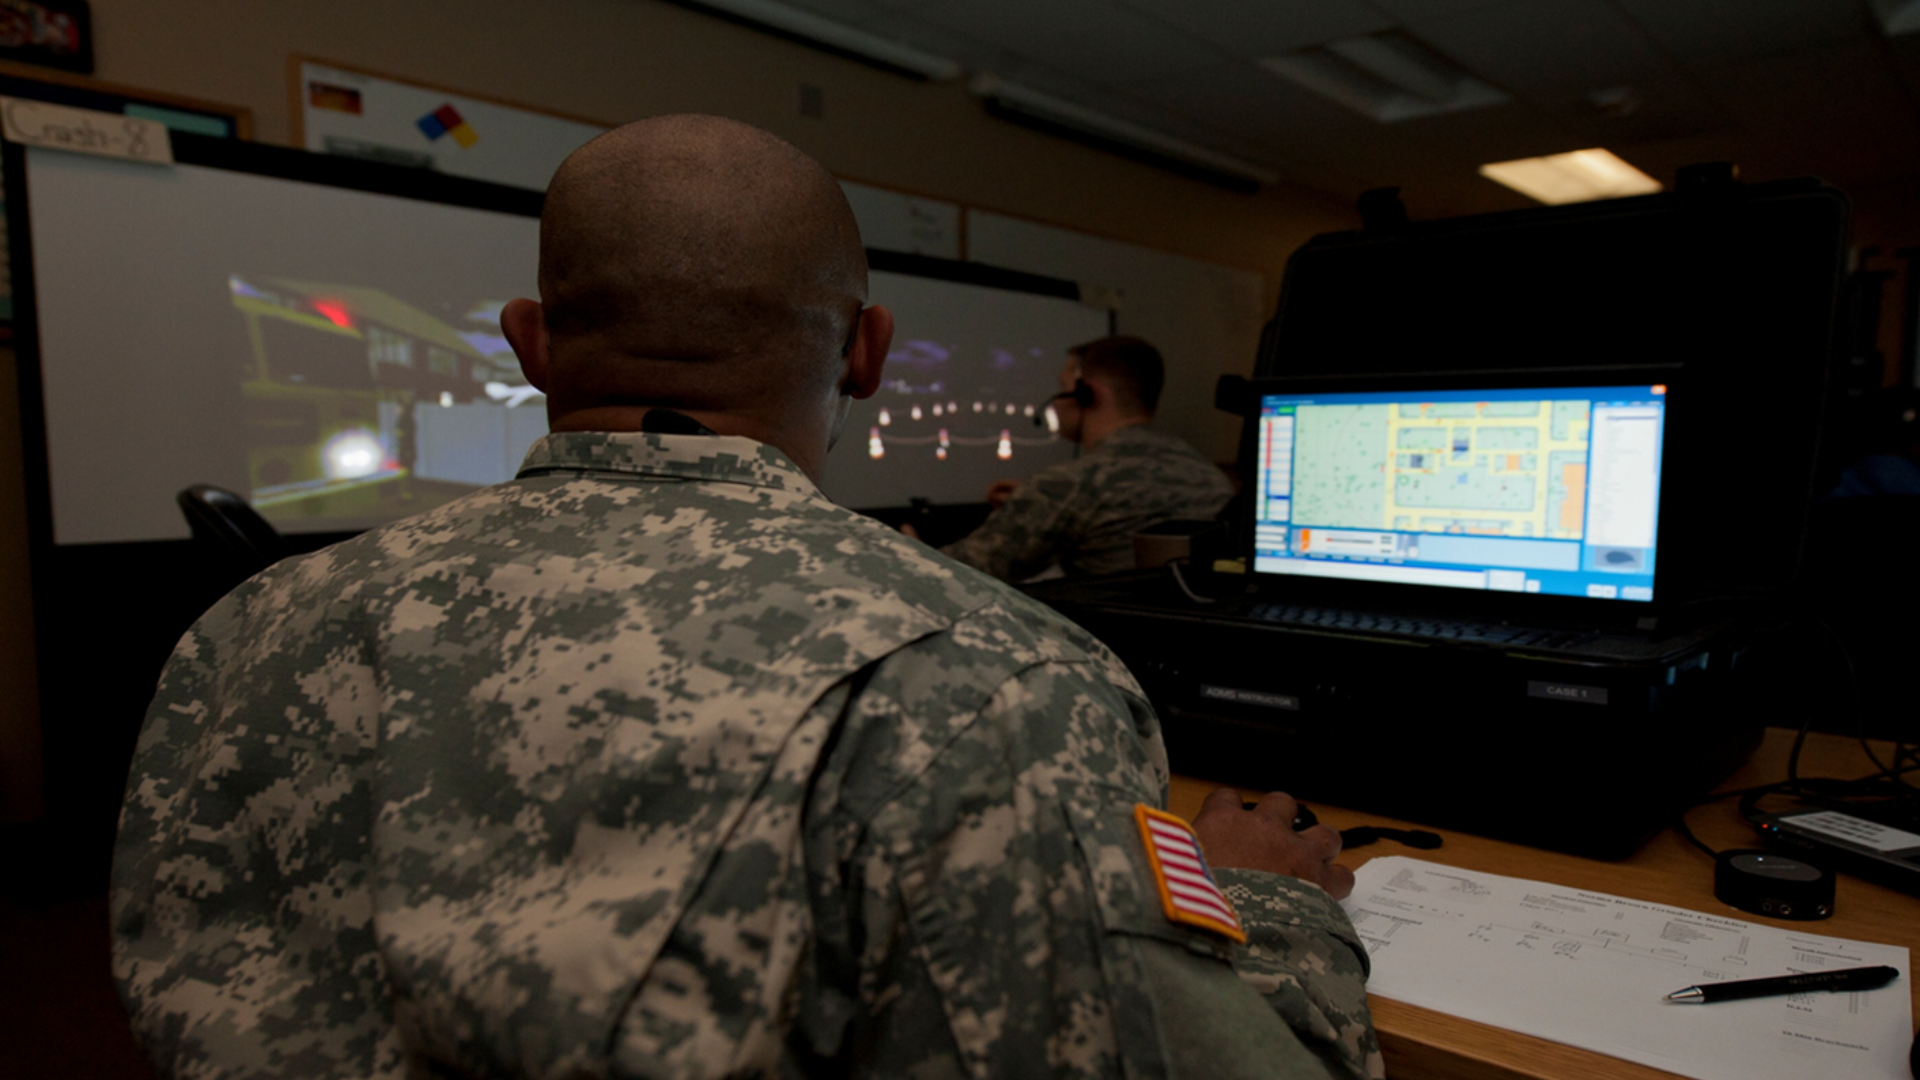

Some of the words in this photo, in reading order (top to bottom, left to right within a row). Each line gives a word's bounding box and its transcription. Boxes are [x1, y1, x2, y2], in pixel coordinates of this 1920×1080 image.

[5, 99, 148, 157] Crash-8
[1238, 692, 1292, 706] INSTRUCTOR
[1546, 686, 1579, 698] CASE
[1581, 689, 1588, 698] 1
